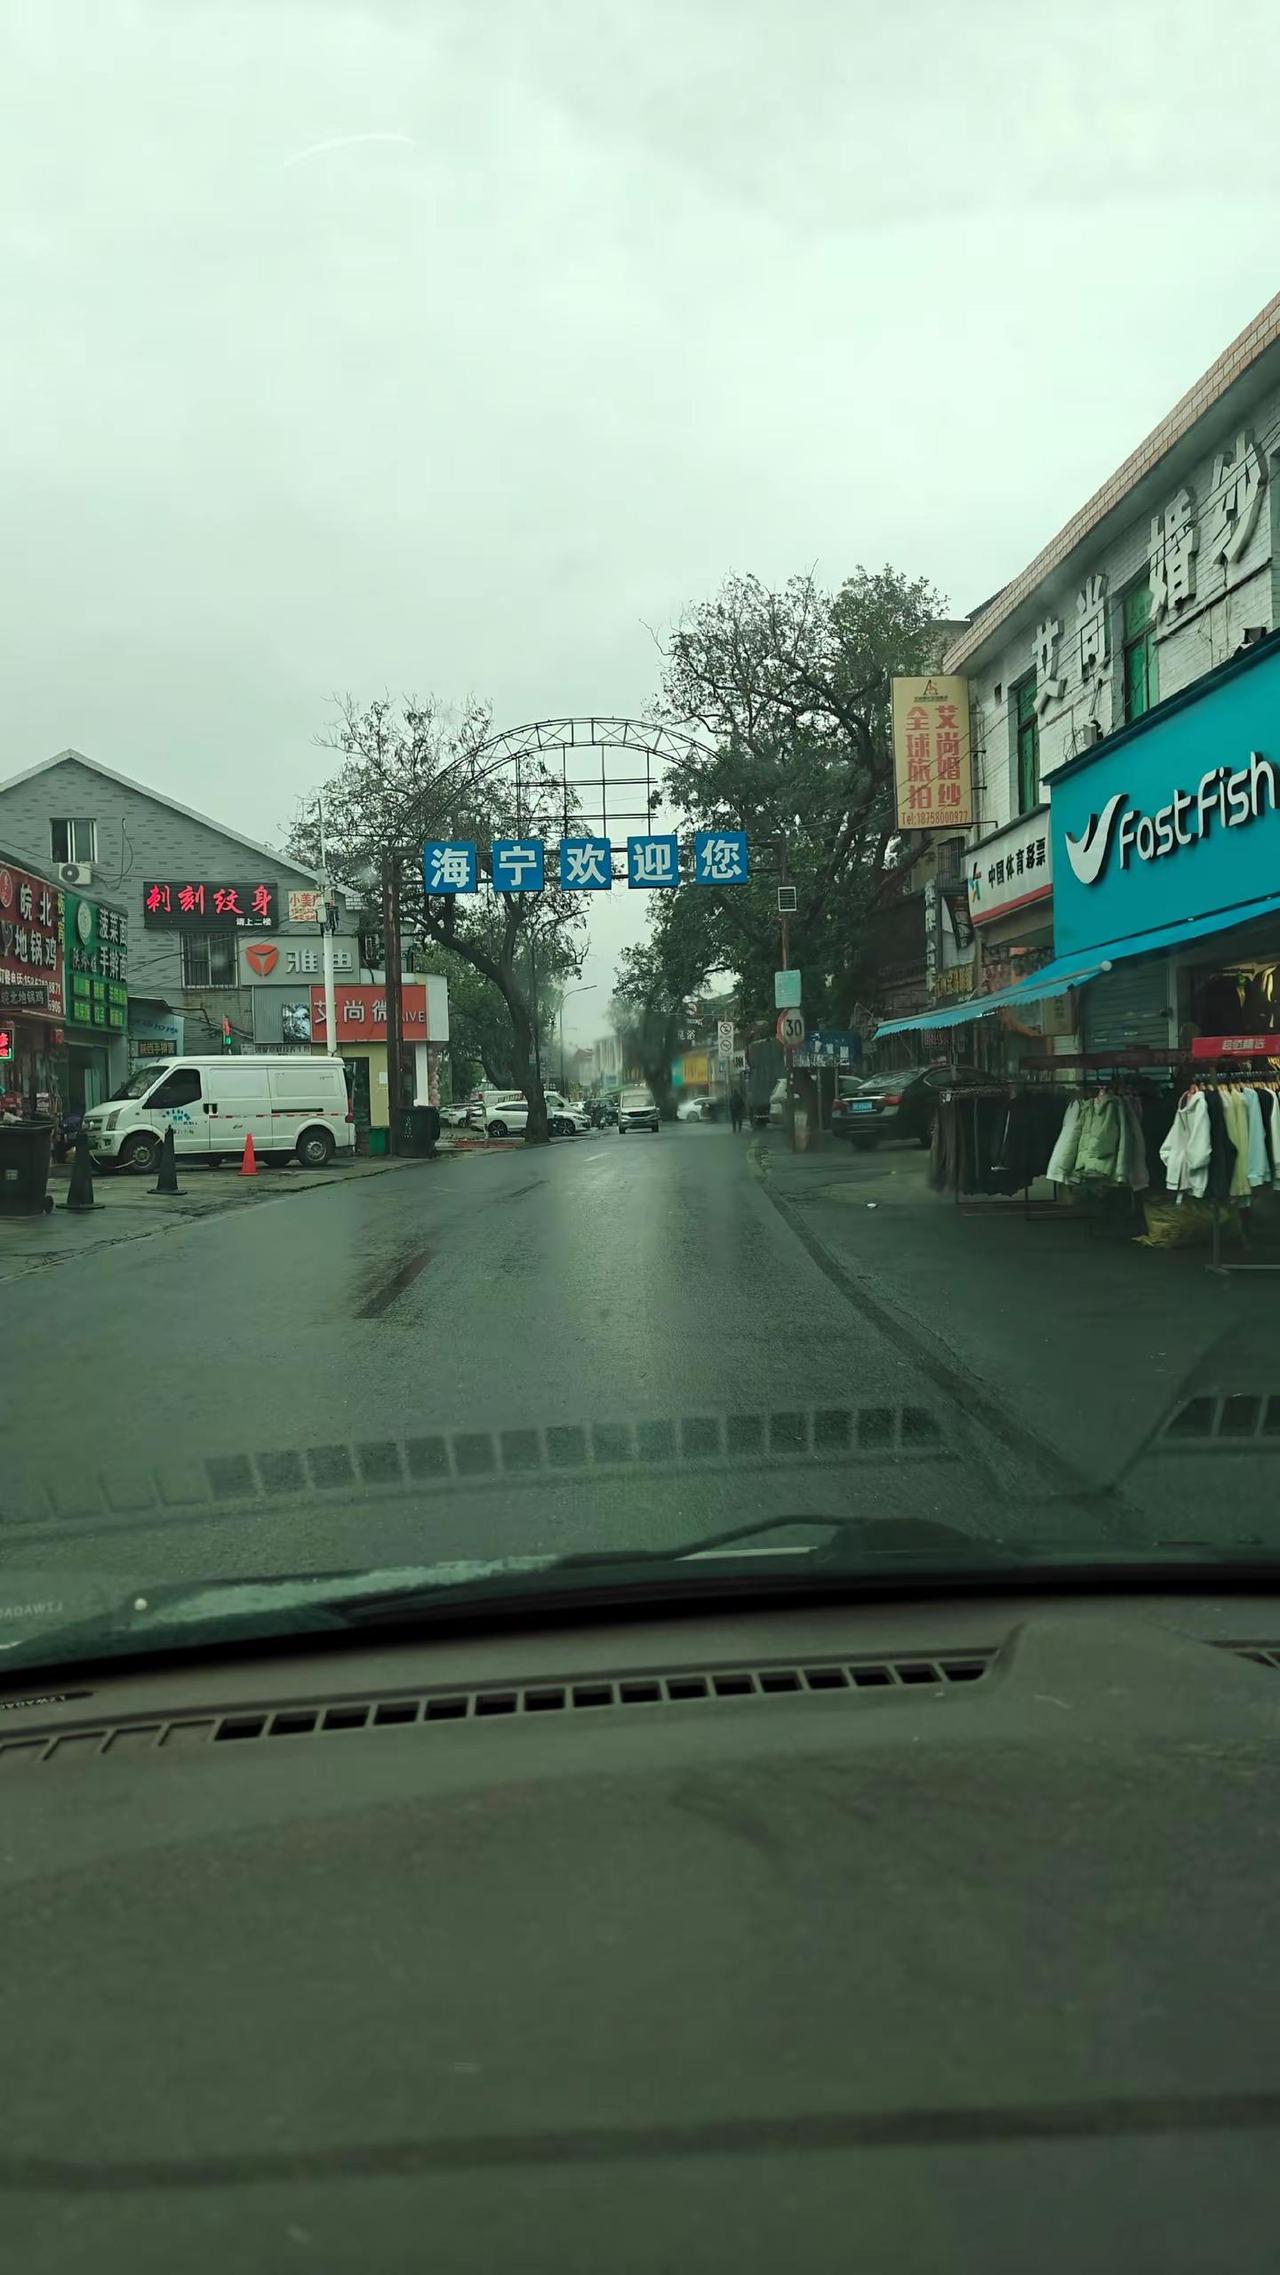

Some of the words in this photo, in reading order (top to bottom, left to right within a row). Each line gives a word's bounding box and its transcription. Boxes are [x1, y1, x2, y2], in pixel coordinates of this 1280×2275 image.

[1032, 430, 1264, 716] 艾尚婚纱
[905, 706, 932, 809] 全球旅拍
[935, 705, 961, 807] 艾尚婚纱
[430, 839, 742, 888] 海宁欢迎您
[988, 837, 1046, 888] 中国体育彩票
[19, 883, 52, 927] 皖北
[146, 885, 272, 916] 刺刻纹身
[236, 917, 272, 927] 请上二楼
[14, 926, 57, 971] 地锅鸡
[785, 1018, 803, 1037] 30
